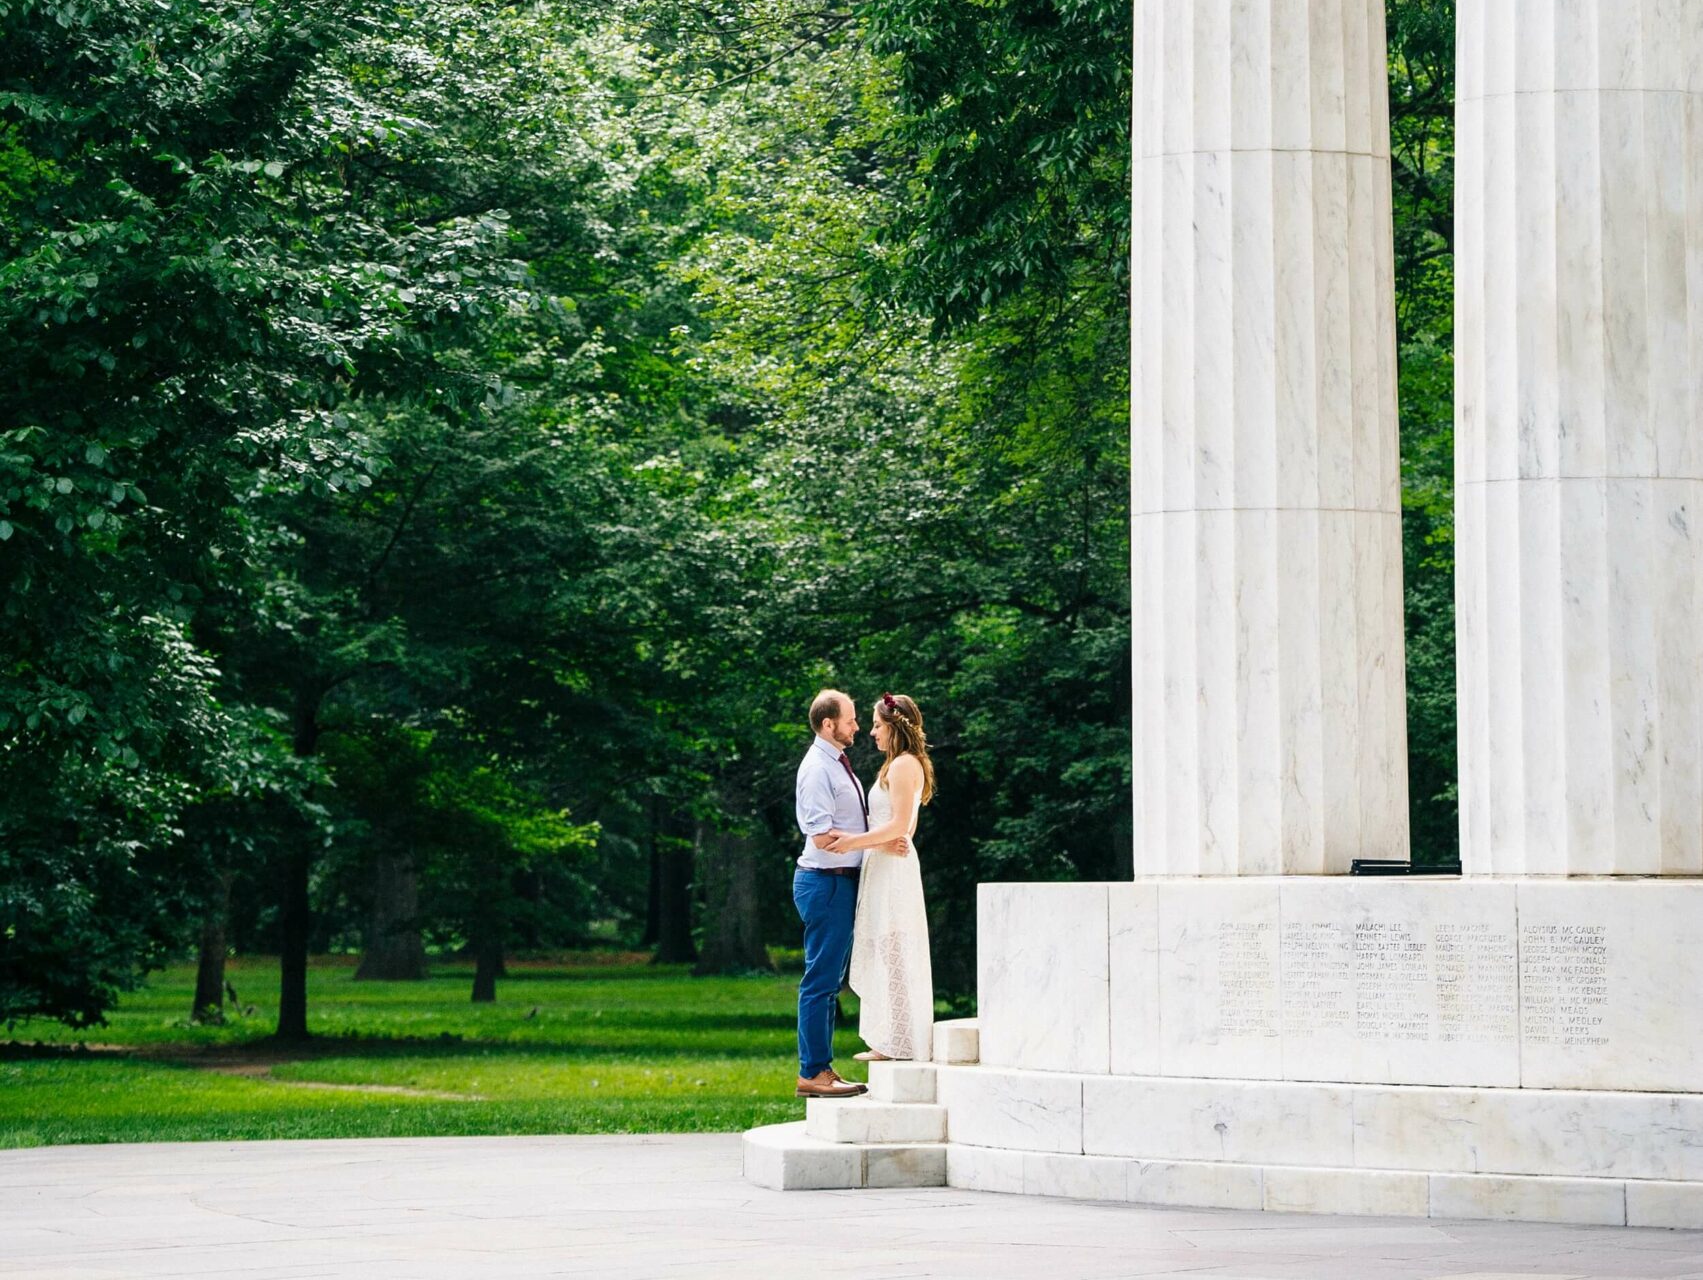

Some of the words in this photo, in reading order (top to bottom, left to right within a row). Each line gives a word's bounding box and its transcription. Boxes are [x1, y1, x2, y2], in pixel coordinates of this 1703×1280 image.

[1389, 923, 1402, 932] LEE
[1523, 926, 1558, 934] ALOYSIUS
[1576, 926, 1607, 934] CAULEY
[1355, 933, 1387, 941] KENNETH
[1390, 933, 1411, 941] LEWIS
[1523, 936, 1546, 945] JOHN
[1574, 936, 1606, 945] CAULEY
[1523, 955, 1551, 965] JOSEPH
[1575, 966, 1606, 975] FADDEN
[1569, 1016, 1604, 1025] MEDLEY
[1524, 1026, 1547, 1035] DAVID
